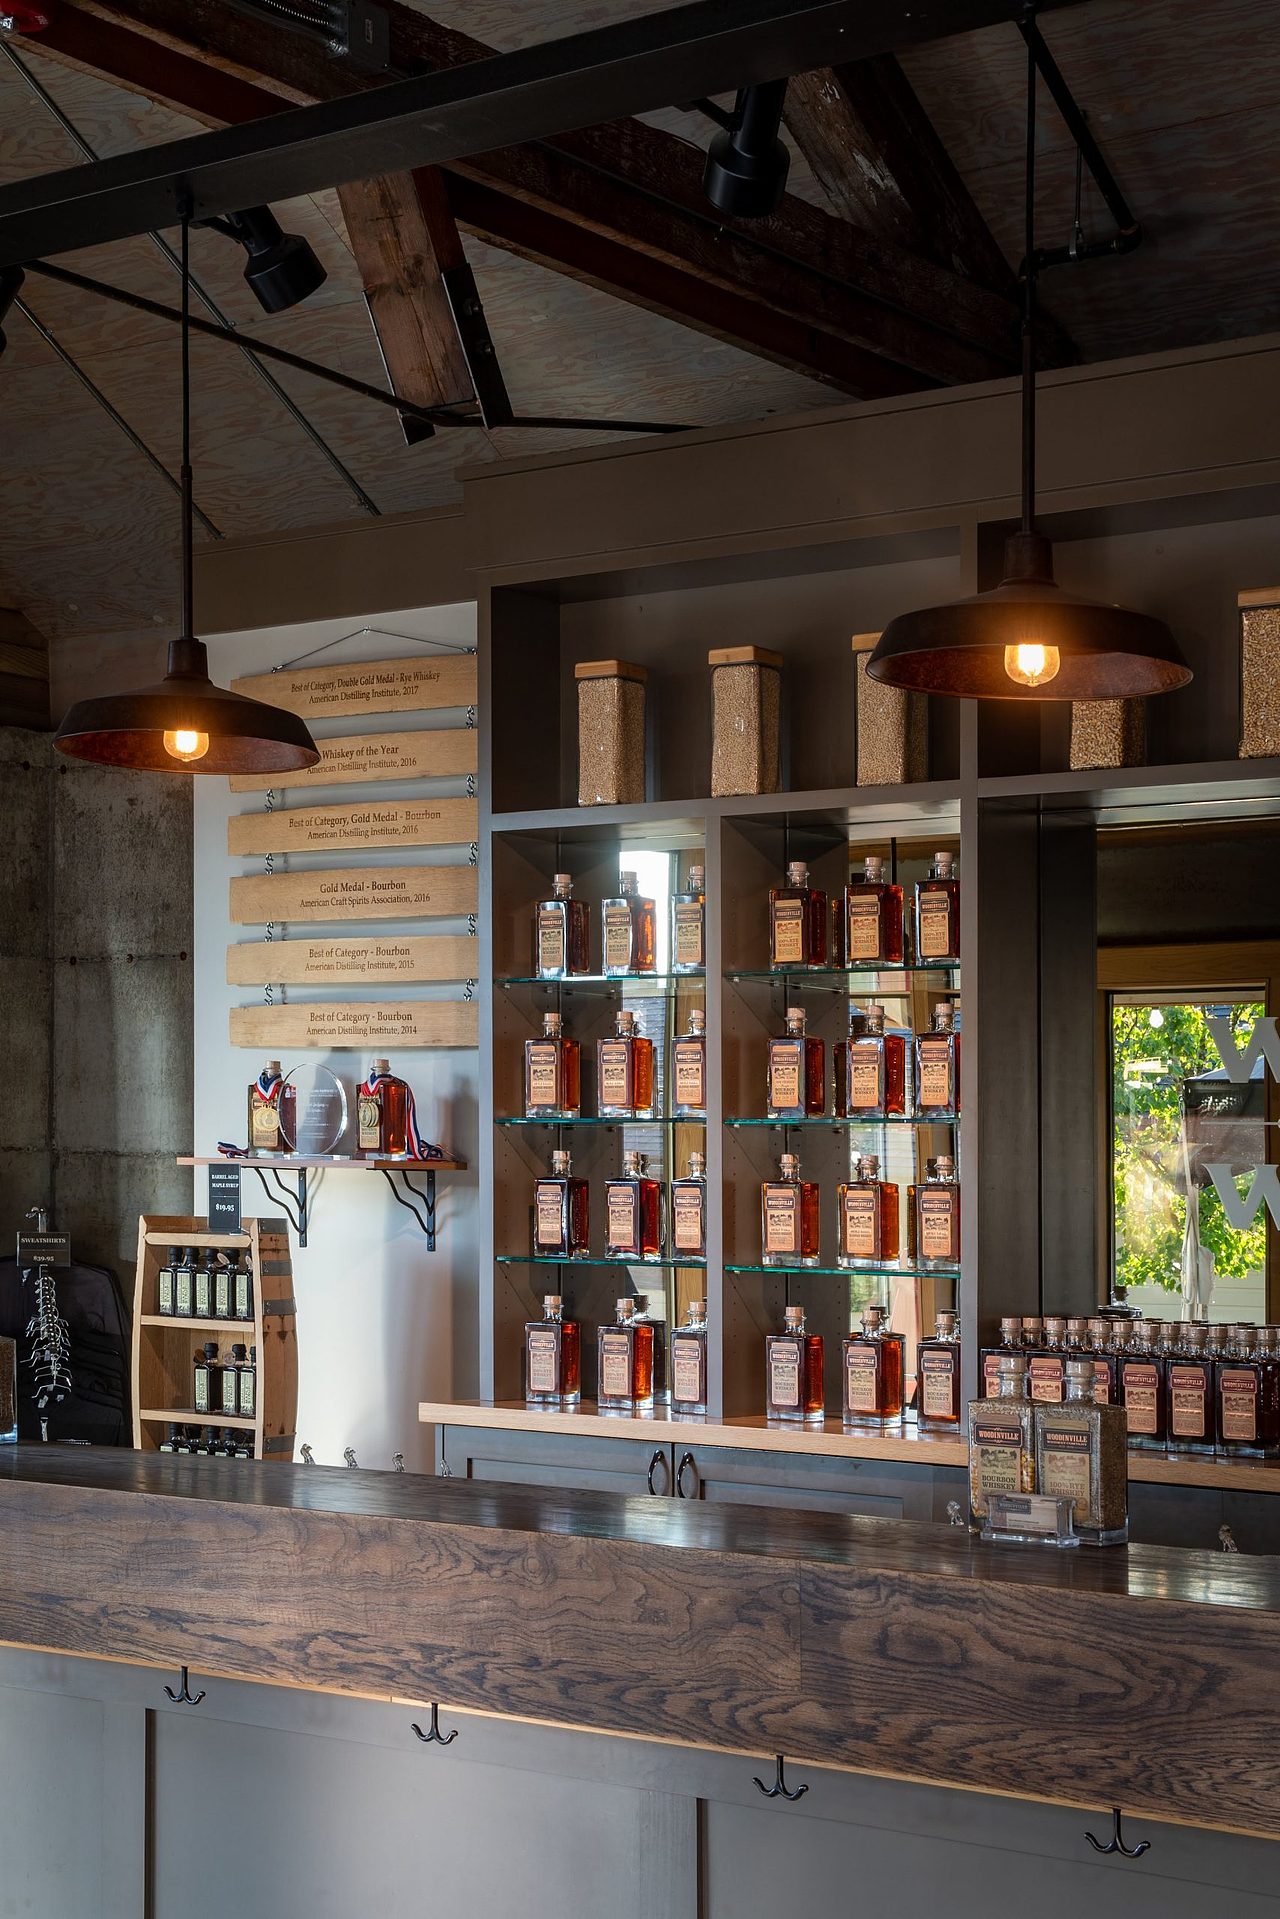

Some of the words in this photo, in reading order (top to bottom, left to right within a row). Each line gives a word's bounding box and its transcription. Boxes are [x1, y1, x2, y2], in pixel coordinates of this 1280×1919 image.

[291, 683, 303, 692] Best
[303, 682, 309, 690] of
[310, 680, 337, 692] Category,
[337, 677, 358, 688] Double
[360, 675, 374, 686] Gold
[376, 673, 394, 684] Medal
[400, 672, 411, 683] Rye
[413, 670, 440, 682] Whiskey
[309, 694, 339, 704] American
[341, 690, 370, 701] Distilling
[372, 688, 401, 698] Institute,
[403, 686, 419, 695] 2017
[322, 749, 354, 760] Whiskey
[356, 747, 364, 756] of
[366, 746, 378, 756] the
[381, 745, 399, 755] Year
[307, 765, 336, 774] American
[338, 761, 367, 772] Distilling
[369, 759, 399, 768] Institute,
[401, 758, 416, 766] 2016
[289, 818, 303, 828] Best
[305, 817, 313, 826] of
[314, 815, 349, 828] Category,
[351, 814, 370, 823] Gold
[372, 812, 398, 822] Medal
[405, 810, 441, 820] Bourbon
[308, 830, 337, 839] American
[339, 828, 369, 839] Distilling
[371, 827, 401, 835] Institute,
[402, 825, 418, 834] 2016
[320, 883, 338, 893] Gold
[340, 882, 364, 892] Medal
[371, 880, 406, 891] Bourbon
[300, 899, 329, 907] American
[331, 897, 347, 906] Craft
[348, 896, 369, 908] Spirits
[371, 895, 412, 904] Association,
[414, 893, 430, 903] 2016
[309, 949, 324, 958] Best
[326, 948, 334, 957] of
[335, 948, 368, 959] Category
[376, 946, 410, 956] Bourbon
[305, 963, 334, 972] American
[336, 961, 366, 972] Distilling
[367, 961, 397, 970] Institute,
[399, 960, 414, 969] 2015
[310, 1012, 325, 1022] Best
[327, 1012, 334, 1021] of
[336, 1012, 370, 1024] Category
[377, 1011, 413, 1021] Bourbon
[306, 1027, 336, 1035] American
[338, 1026, 368, 1037] Distilling
[369, 1026, 400, 1035] Institute,
[401, 1026, 417, 1034] 2014
[216, 1203, 234, 1211] $19.95
[979, 1430, 1018, 1440] WOODINVILLE
[1046, 1433, 1088, 1443] WOODINVILLE
[982, 1475, 1015, 1484] BOURBON
[982, 1482, 1015, 1490] WHISKEY
[1050, 1488, 1085, 1496] WHISKEY
